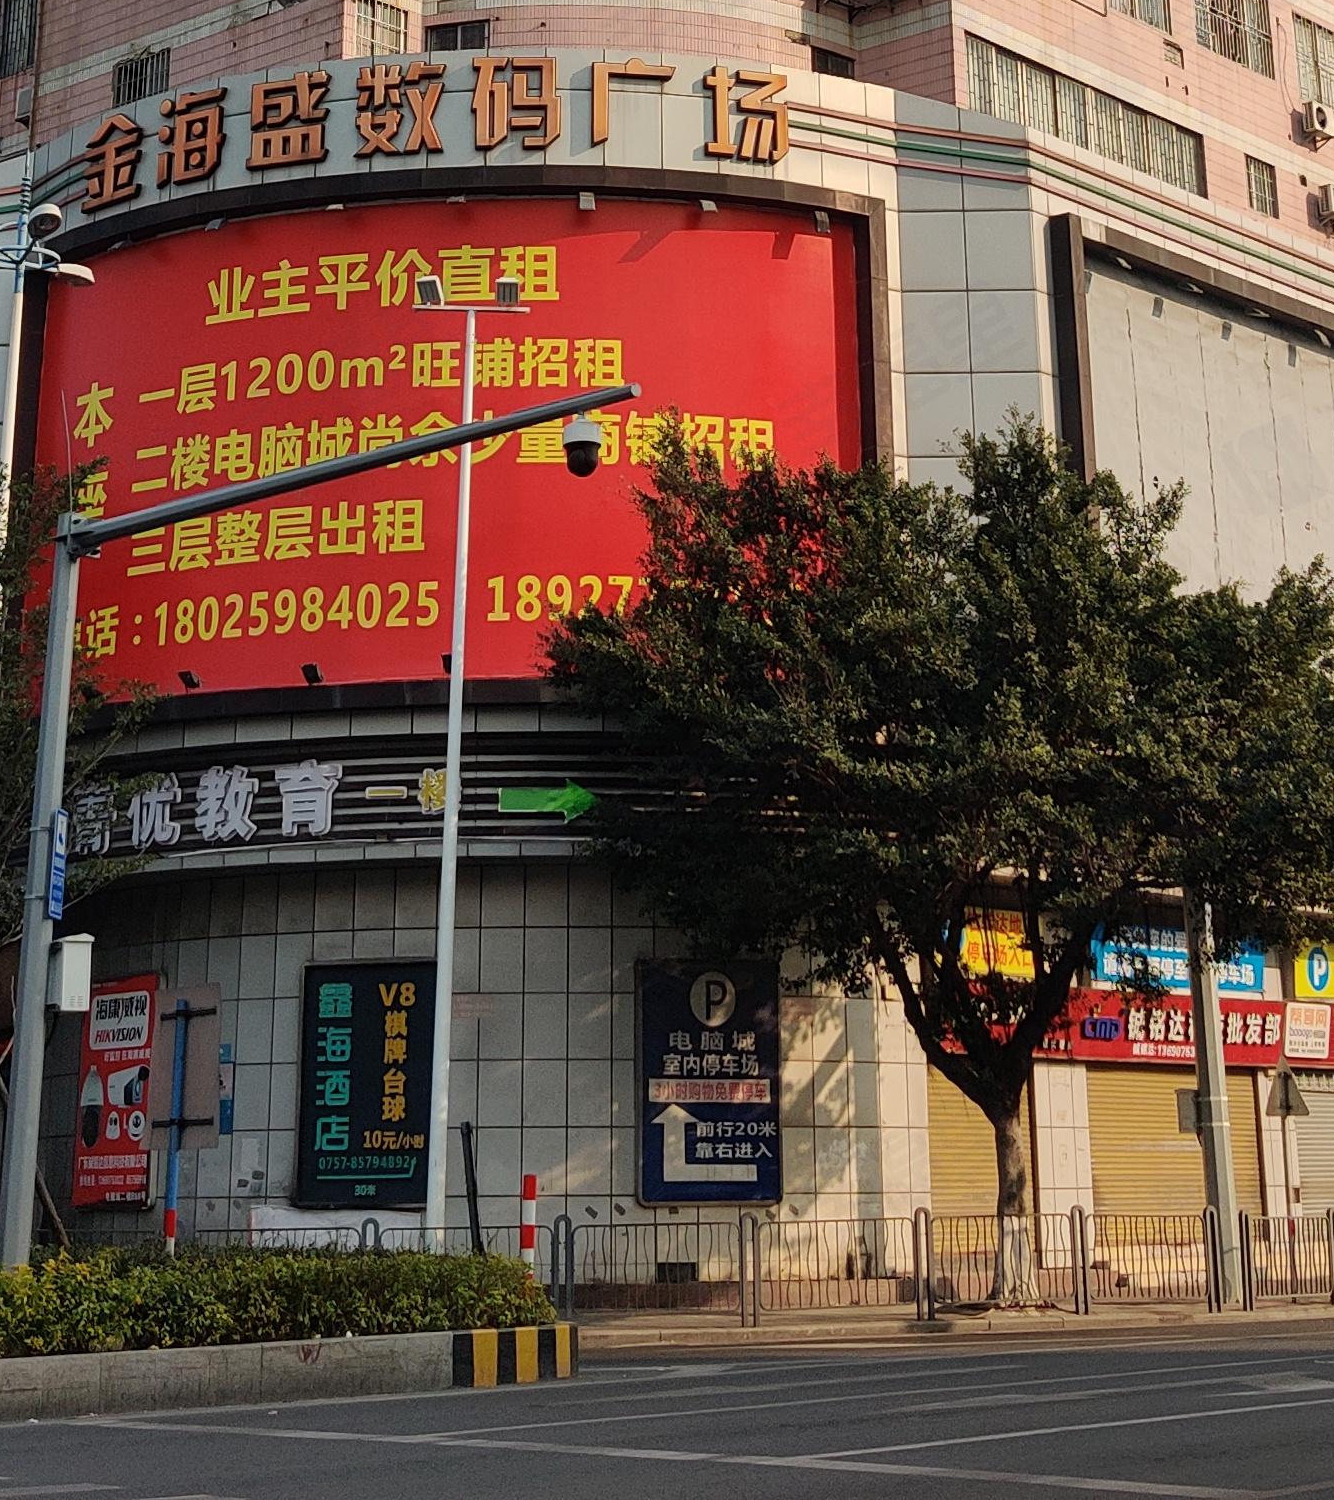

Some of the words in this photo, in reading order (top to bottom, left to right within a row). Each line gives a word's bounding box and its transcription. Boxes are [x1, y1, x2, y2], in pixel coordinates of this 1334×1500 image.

[80, 55, 791, 213] 金海盛数码广场
[205, 244, 560, 326] 业主平价直租
[127, 499, 425, 577] 三层整层出租
[378, 982, 416, 1007] V8
[704, 980, 727, 1021] P
[94, 1026, 144, 1045] HIKVISION
[669, 1030, 757, 1052] 电脑城
[314, 982, 353, 1151] 鑫海酒店
[381, 1010, 408, 1122] 棋牌台球
[662, 1053, 760, 1077] 室内停车场
[653, 1081, 768, 1099] 3小时购物免费停车
[695, 1121, 778, 1138] 前行20米
[694, 1142, 774, 1159] 靠右进入
